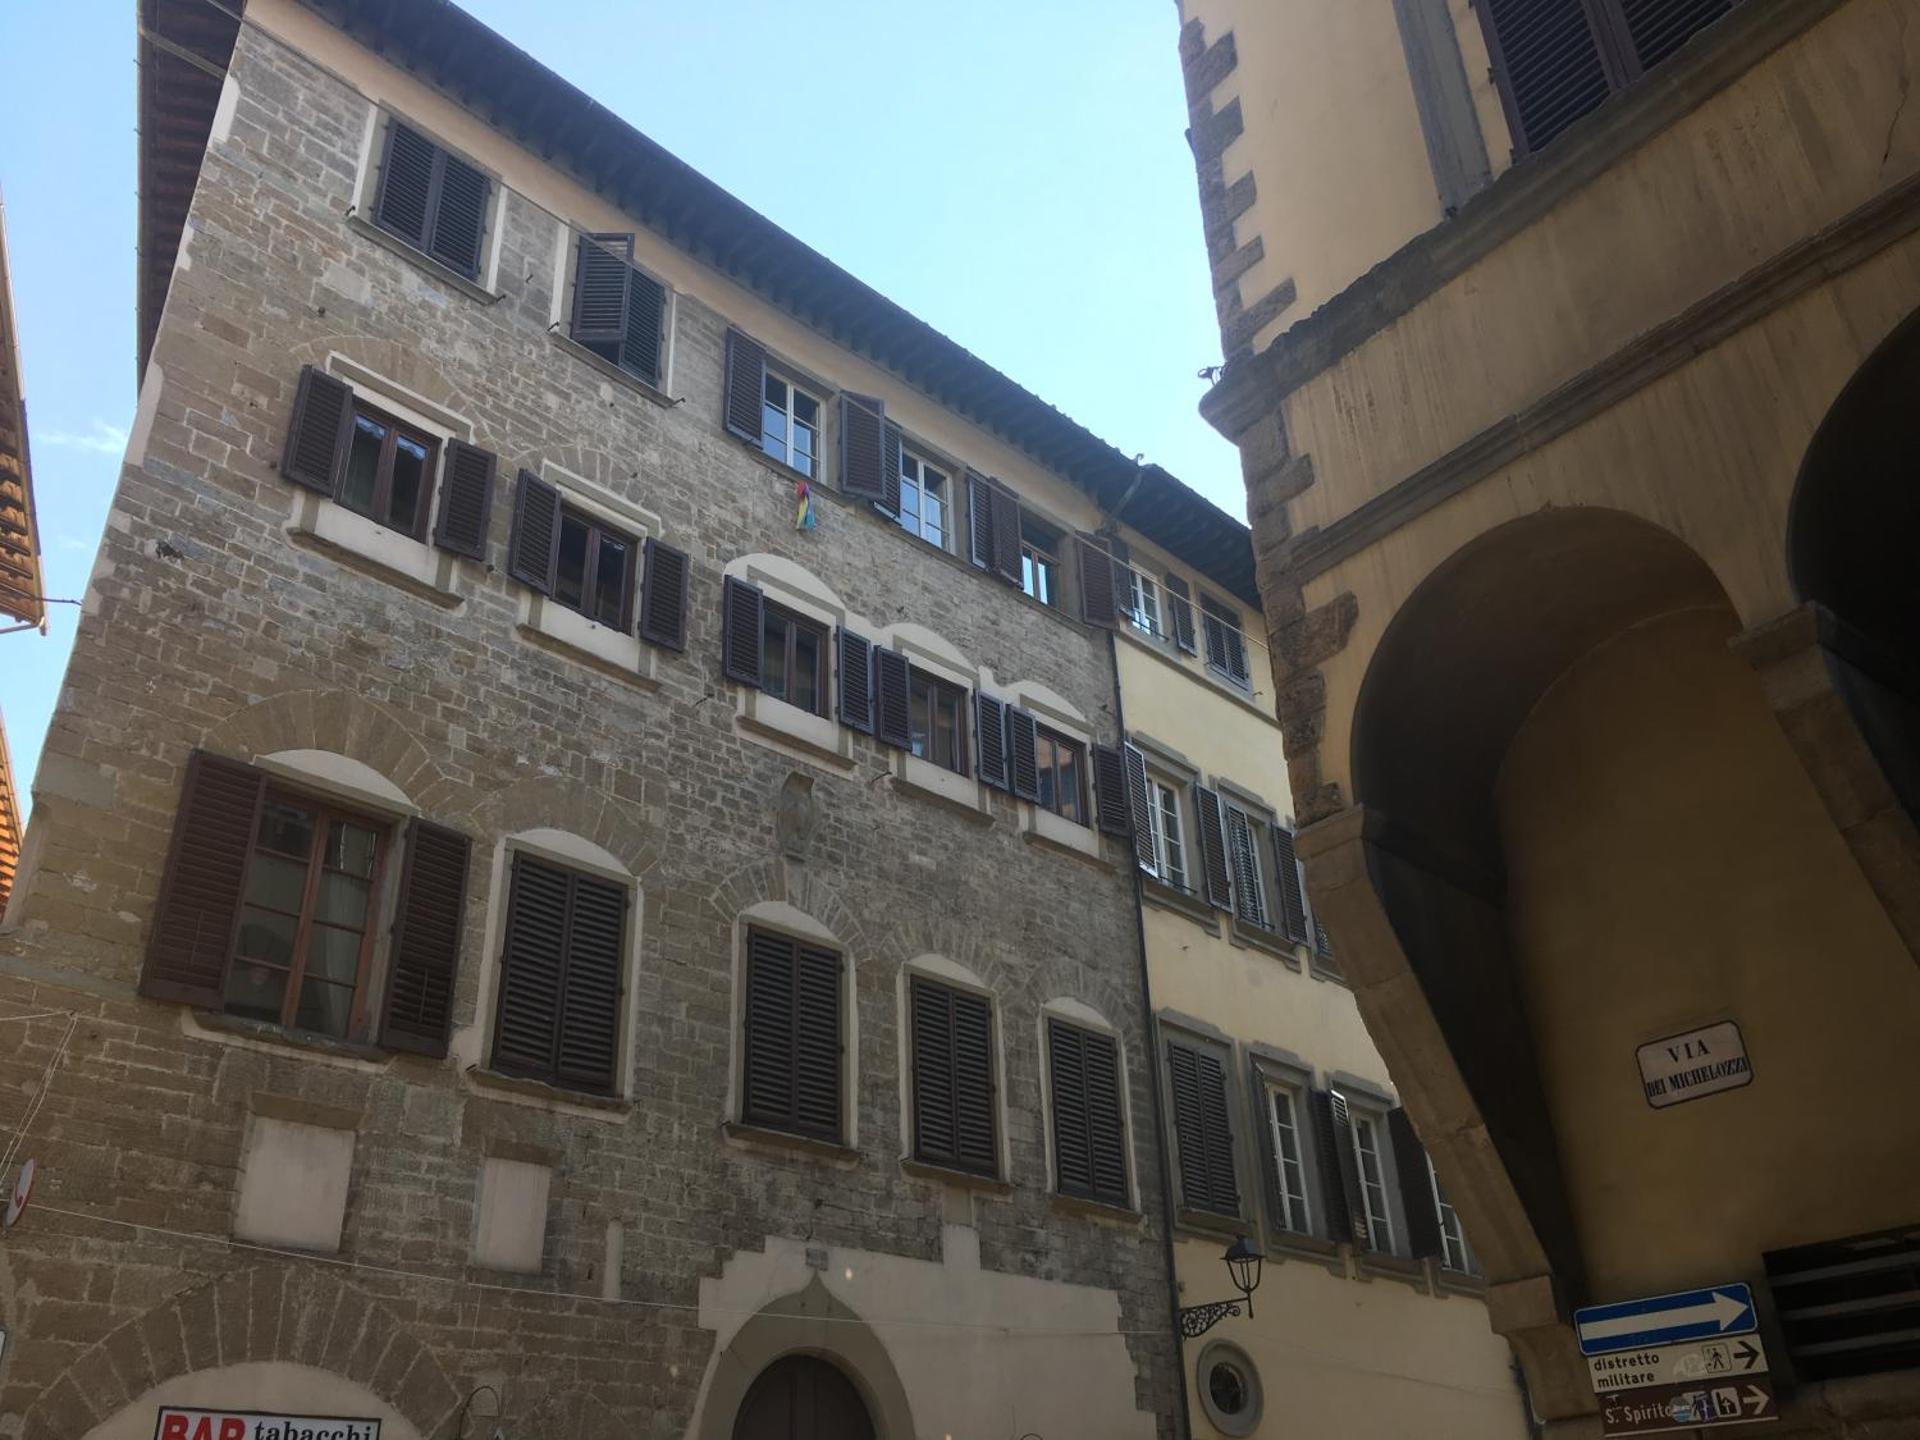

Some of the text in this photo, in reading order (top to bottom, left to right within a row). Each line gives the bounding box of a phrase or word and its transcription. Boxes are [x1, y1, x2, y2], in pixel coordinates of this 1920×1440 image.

[1667, 1039, 1710, 1063] VIA
[1646, 1057, 1748, 1097] DEI MICHELOZZI
[1594, 1354, 1660, 1371] distretto
[1598, 1372, 1655, 1388] militare
[254, 1421, 371, 1440] tabacchi
